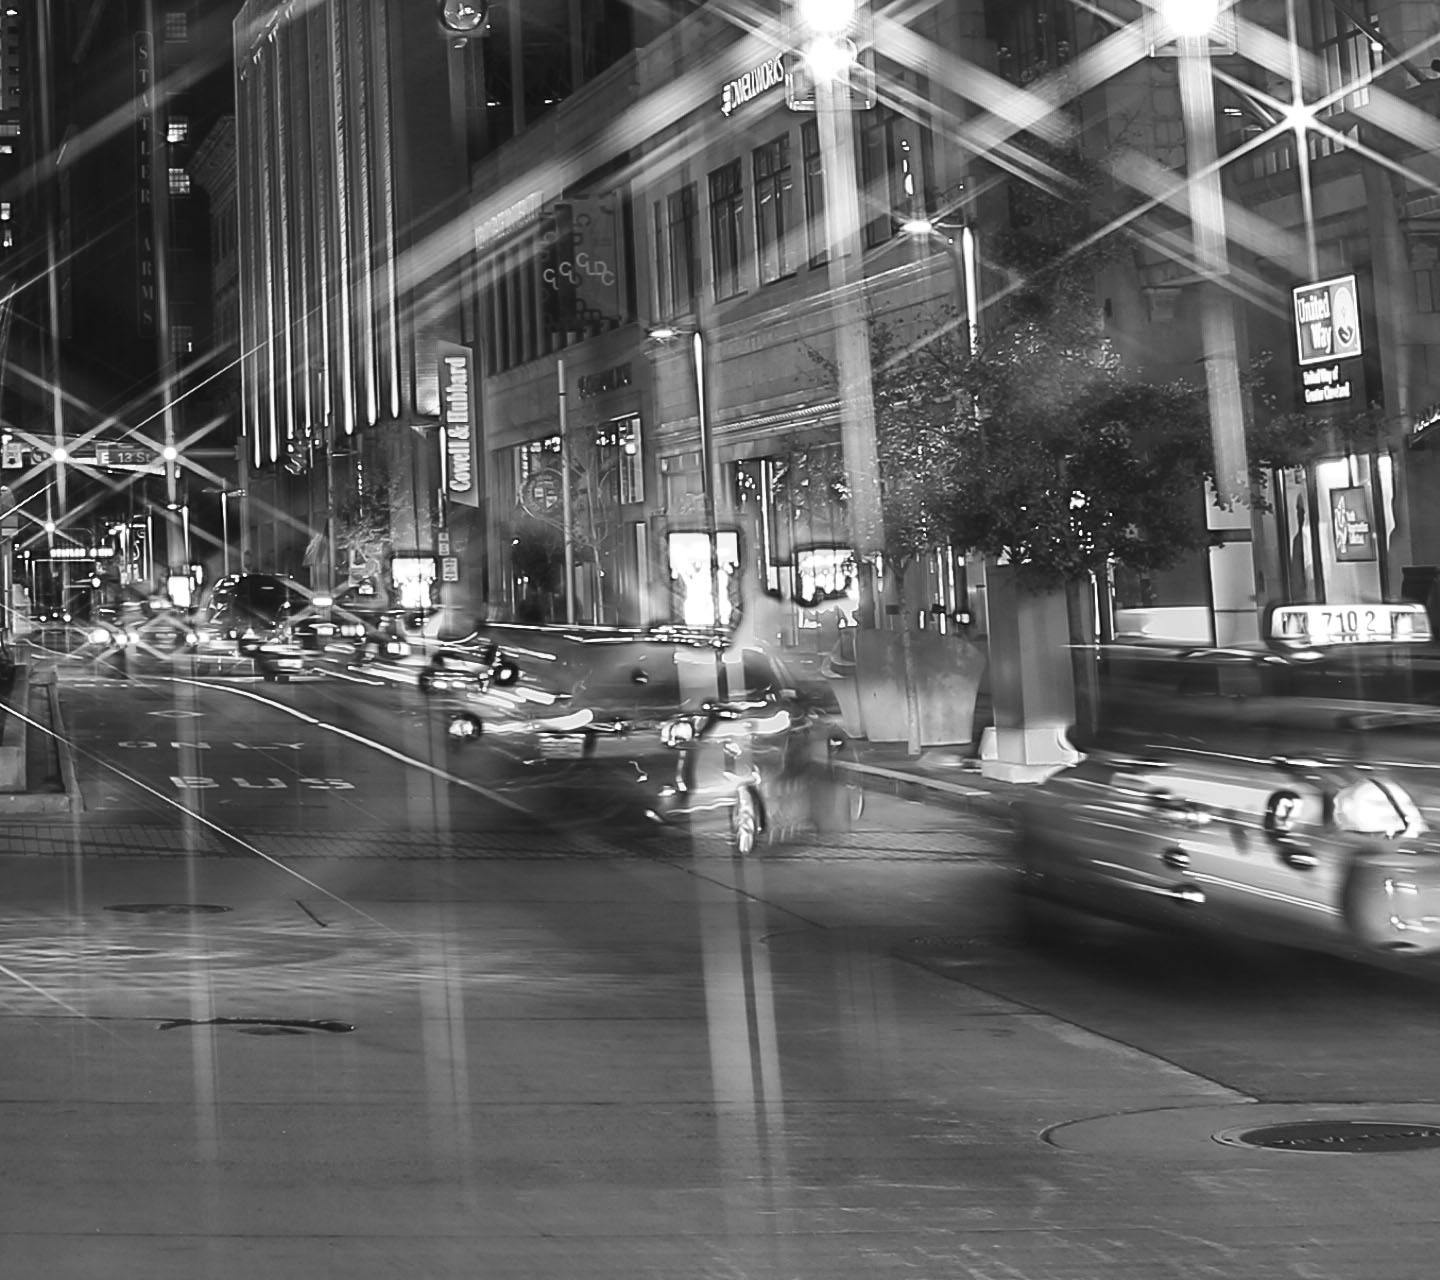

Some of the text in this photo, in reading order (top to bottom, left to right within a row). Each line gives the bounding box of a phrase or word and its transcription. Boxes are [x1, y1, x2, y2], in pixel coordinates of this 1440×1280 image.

[445, 356, 471, 492] Cowell & Hubbard
[117, 740, 305, 751] ONLY
[169, 775, 356, 790] BUS
